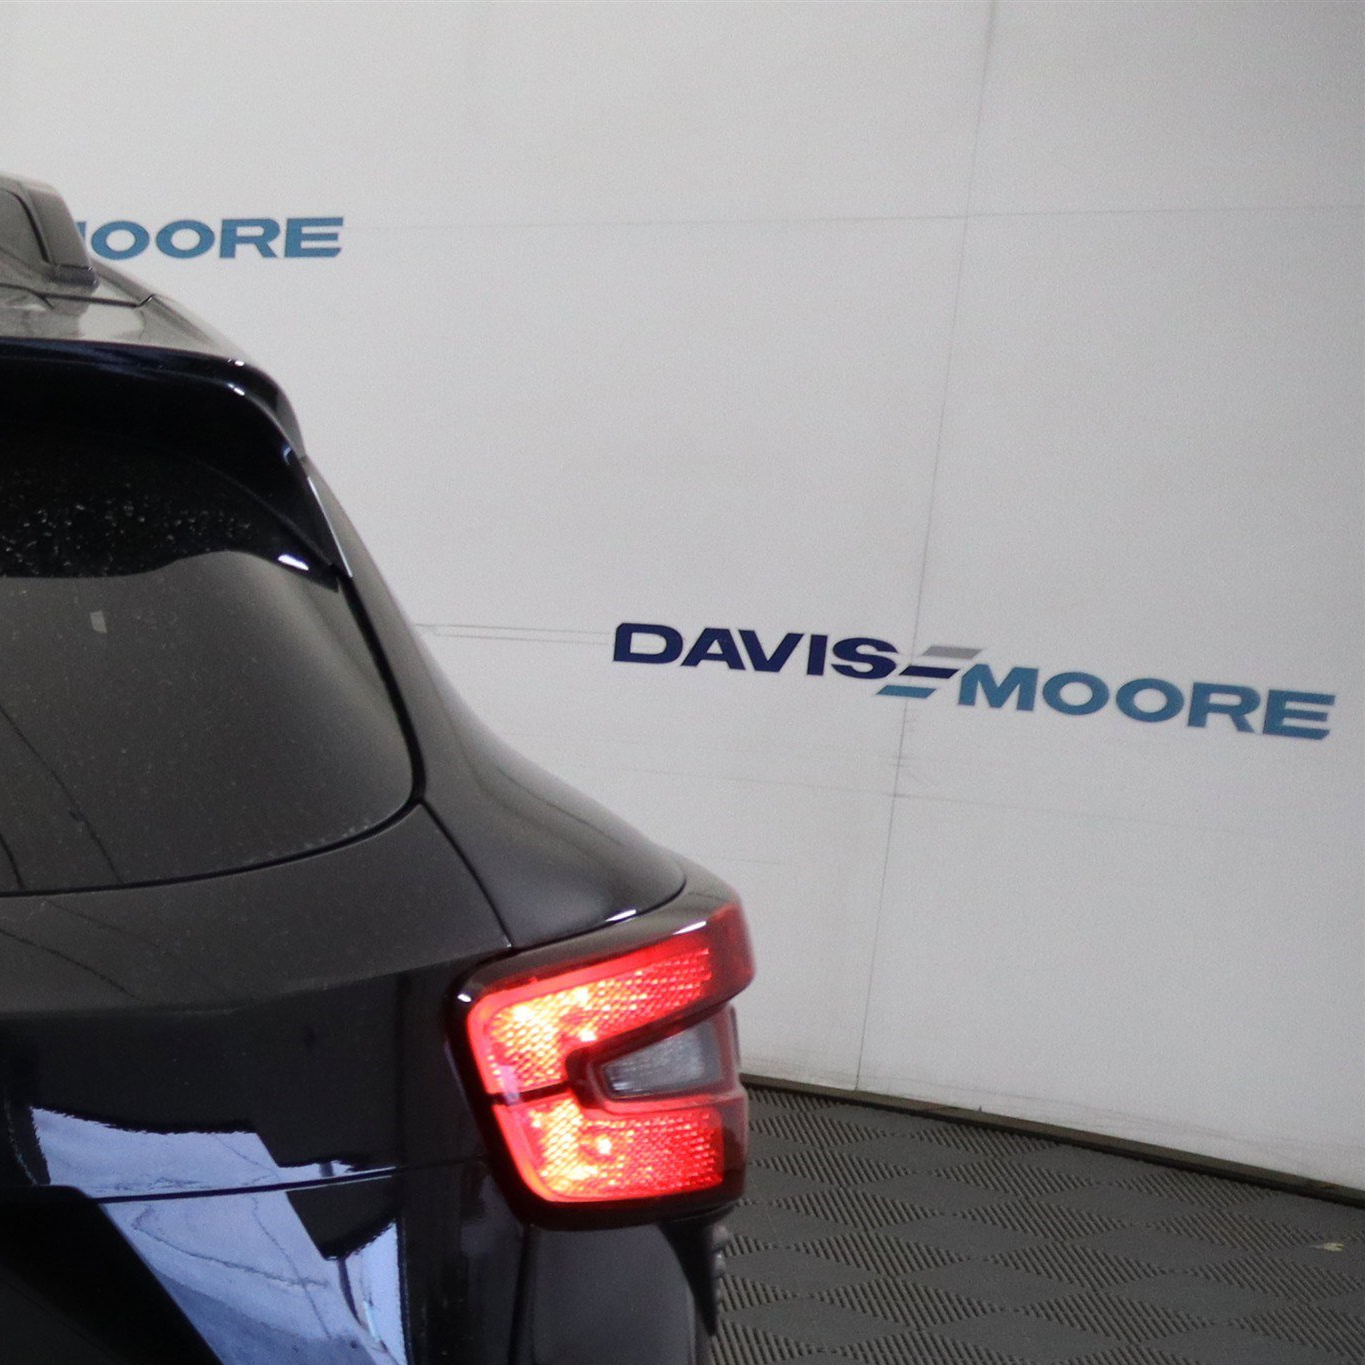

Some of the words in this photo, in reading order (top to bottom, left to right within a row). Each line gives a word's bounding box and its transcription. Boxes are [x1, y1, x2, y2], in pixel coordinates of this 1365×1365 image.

[76, 216, 344, 260] OORE
[611, 622, 900, 680] DAVIS
[958, 663, 1336, 741] MOORE
